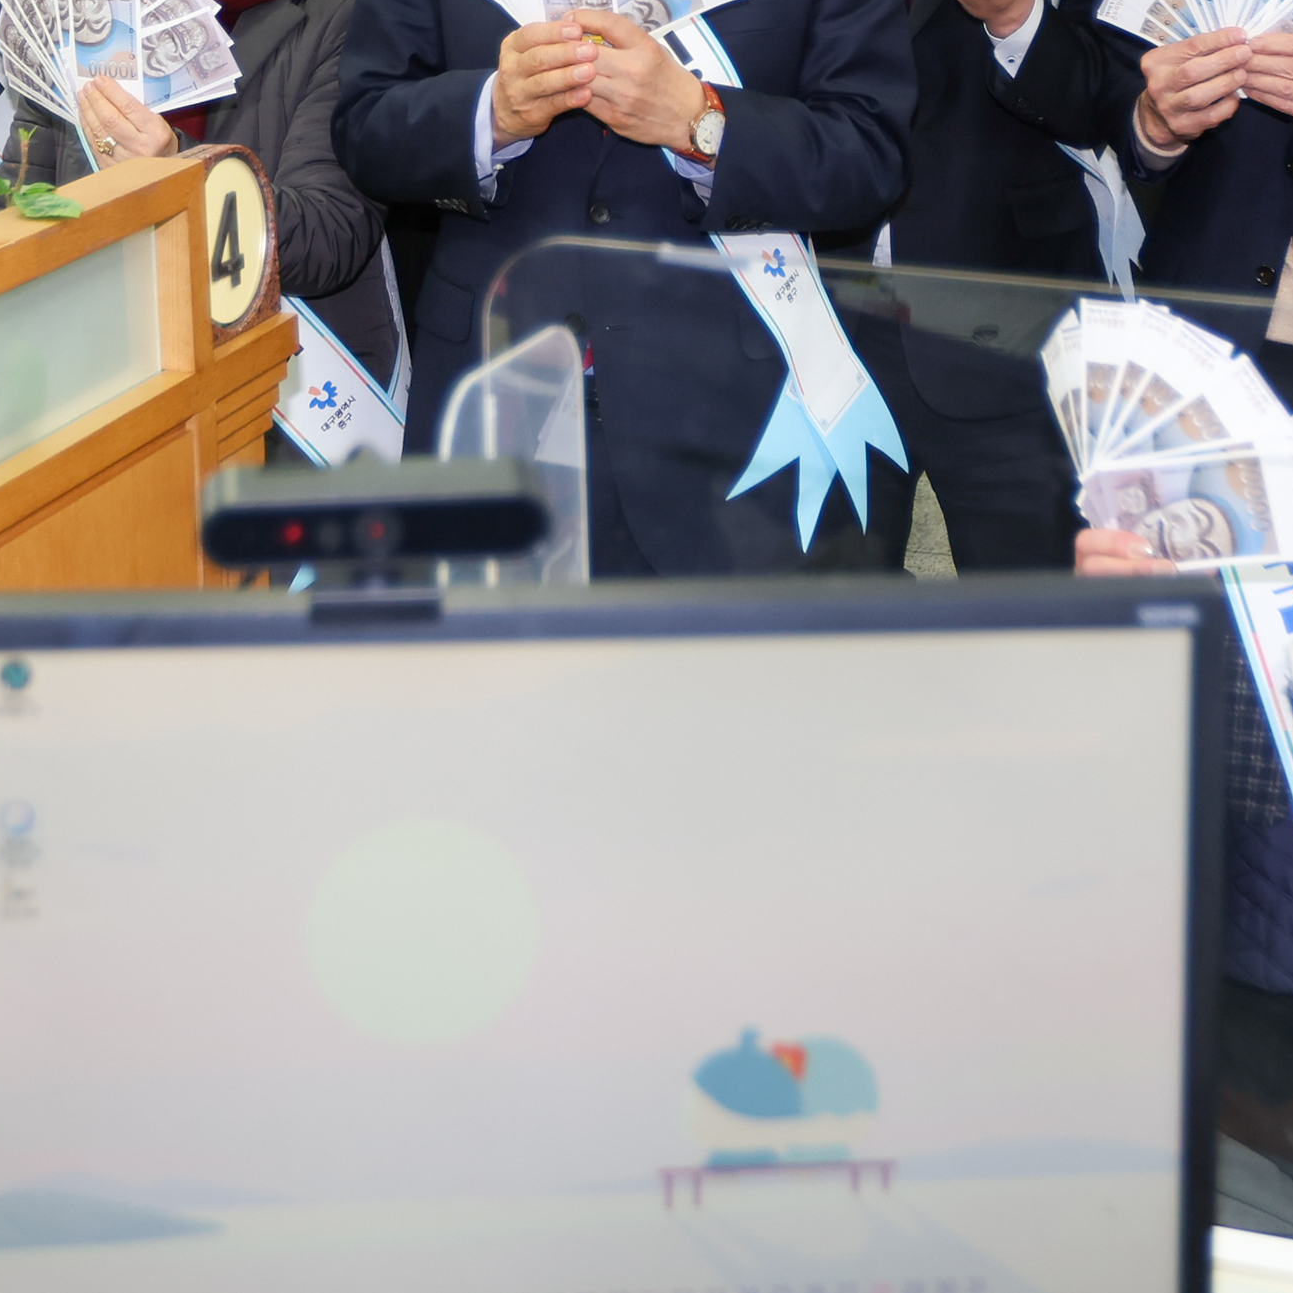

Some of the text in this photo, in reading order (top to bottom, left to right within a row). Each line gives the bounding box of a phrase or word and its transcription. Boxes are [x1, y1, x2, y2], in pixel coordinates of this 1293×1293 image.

[88, 59, 138, 79] 10000
[212, 190, 245, 288] 4
[774, 269, 799, 301] 대구광역시
[321, 395, 357, 432] 대구광역시
[337, 412, 352, 430] 중구
